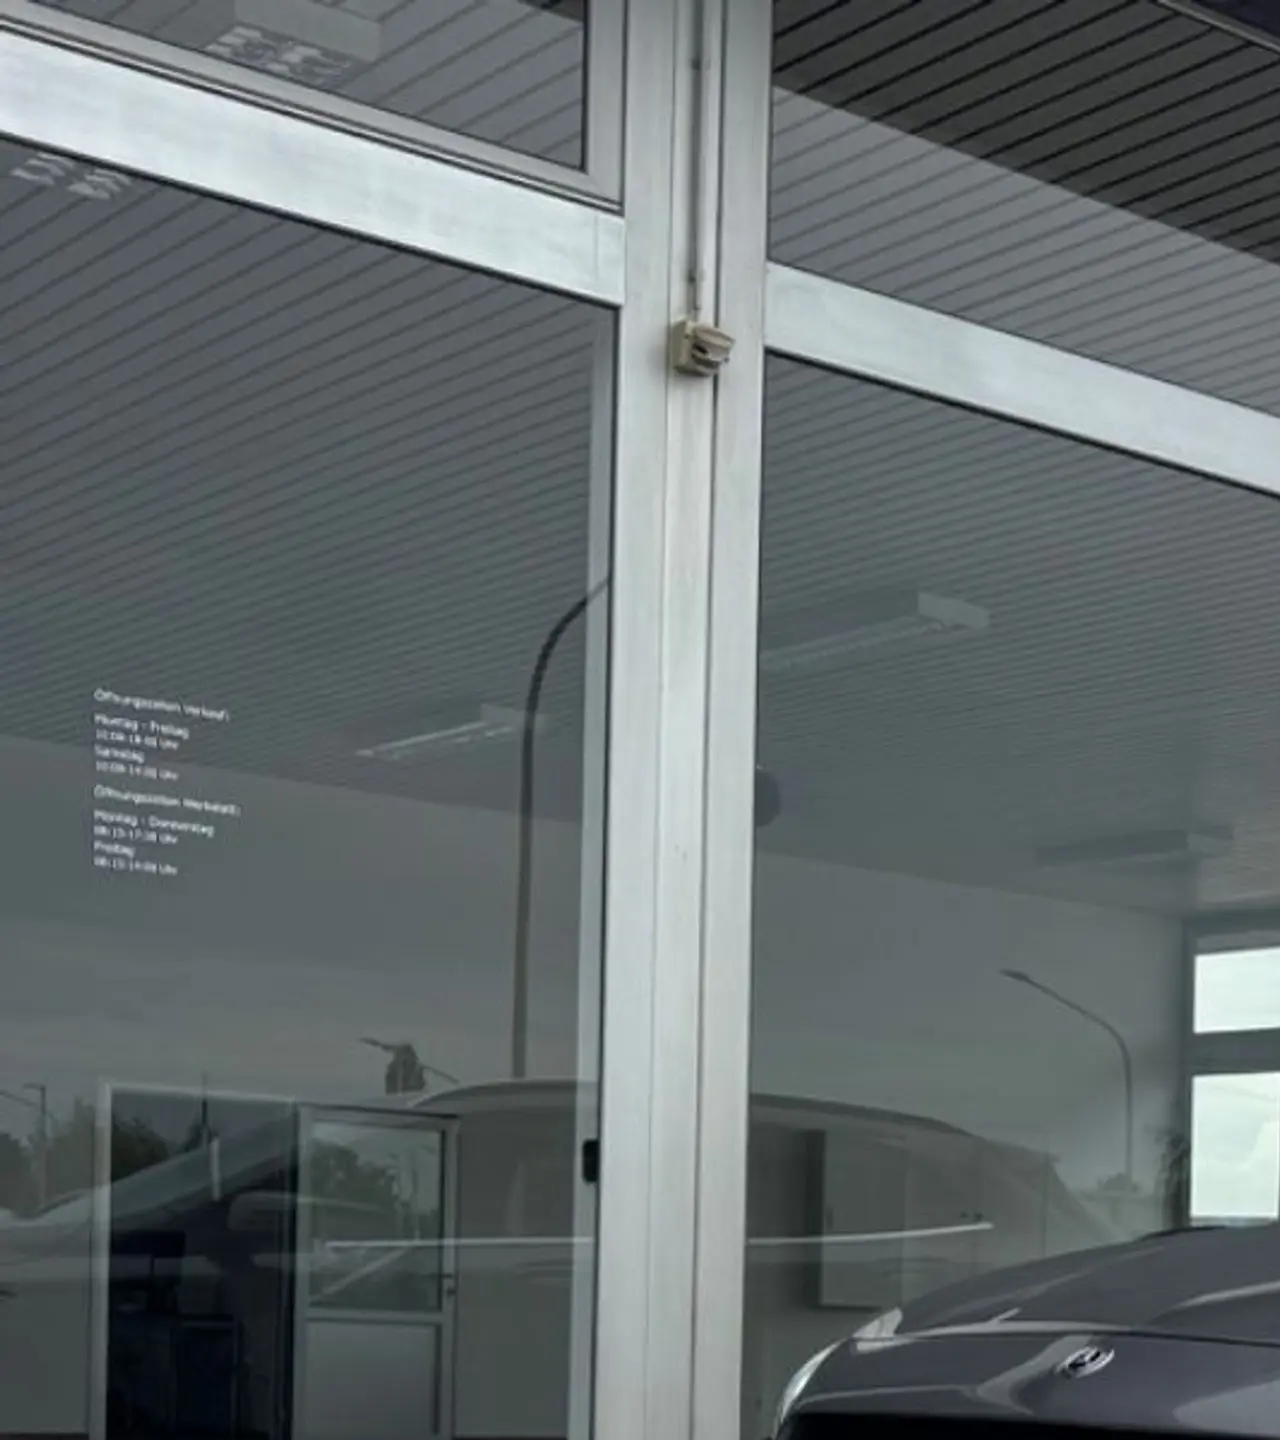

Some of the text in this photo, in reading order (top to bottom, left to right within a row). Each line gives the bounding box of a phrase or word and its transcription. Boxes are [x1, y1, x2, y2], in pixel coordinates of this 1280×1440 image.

[94, 712, 138, 733] Montag
[149, 719, 190, 741] Freitag
[94, 743, 146, 765] Samstag
[94, 809, 138, 828] Montag
[148, 815, 215, 839] Donnerstag
[94, 840, 136, 859] Freitag
